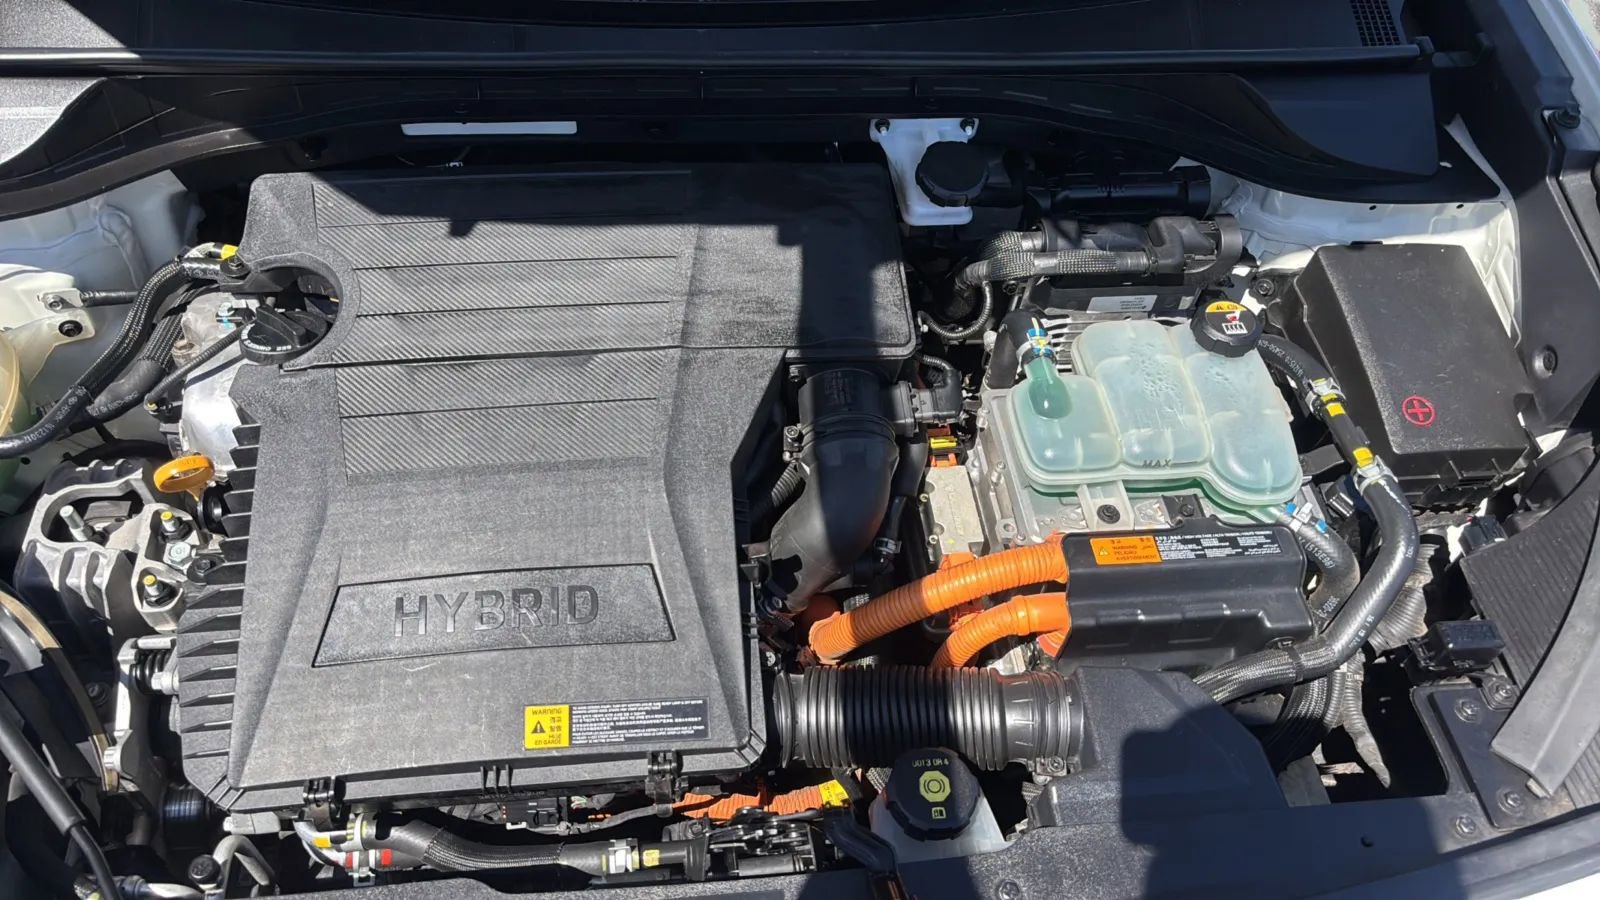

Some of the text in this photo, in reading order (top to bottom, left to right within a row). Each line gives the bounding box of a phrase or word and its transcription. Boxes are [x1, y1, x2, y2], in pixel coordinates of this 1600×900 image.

[1142, 459, 1172, 469] MAX
[394, 584, 599, 637] HYBRID
[531, 707, 562, 716] WARNING
